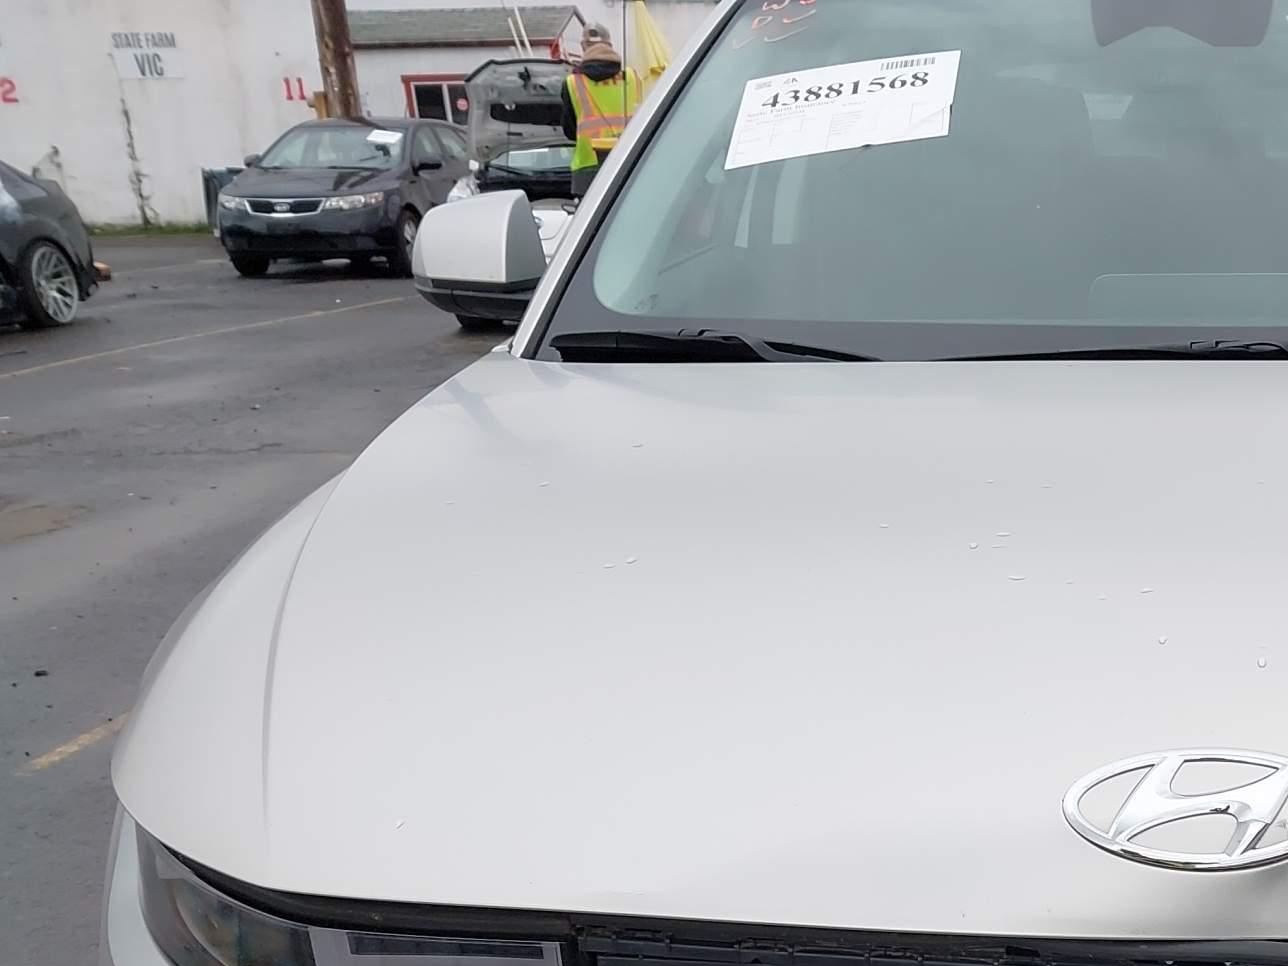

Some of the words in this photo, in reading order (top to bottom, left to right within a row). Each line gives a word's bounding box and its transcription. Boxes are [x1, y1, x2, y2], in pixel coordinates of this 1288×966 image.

[111, 32, 143, 48] STATE
[145, 32, 177, 48] FARM
[133, 52, 165, 77] VIC
[283, 77, 306, 101] 11
[761, 71, 930, 109] 43881568
